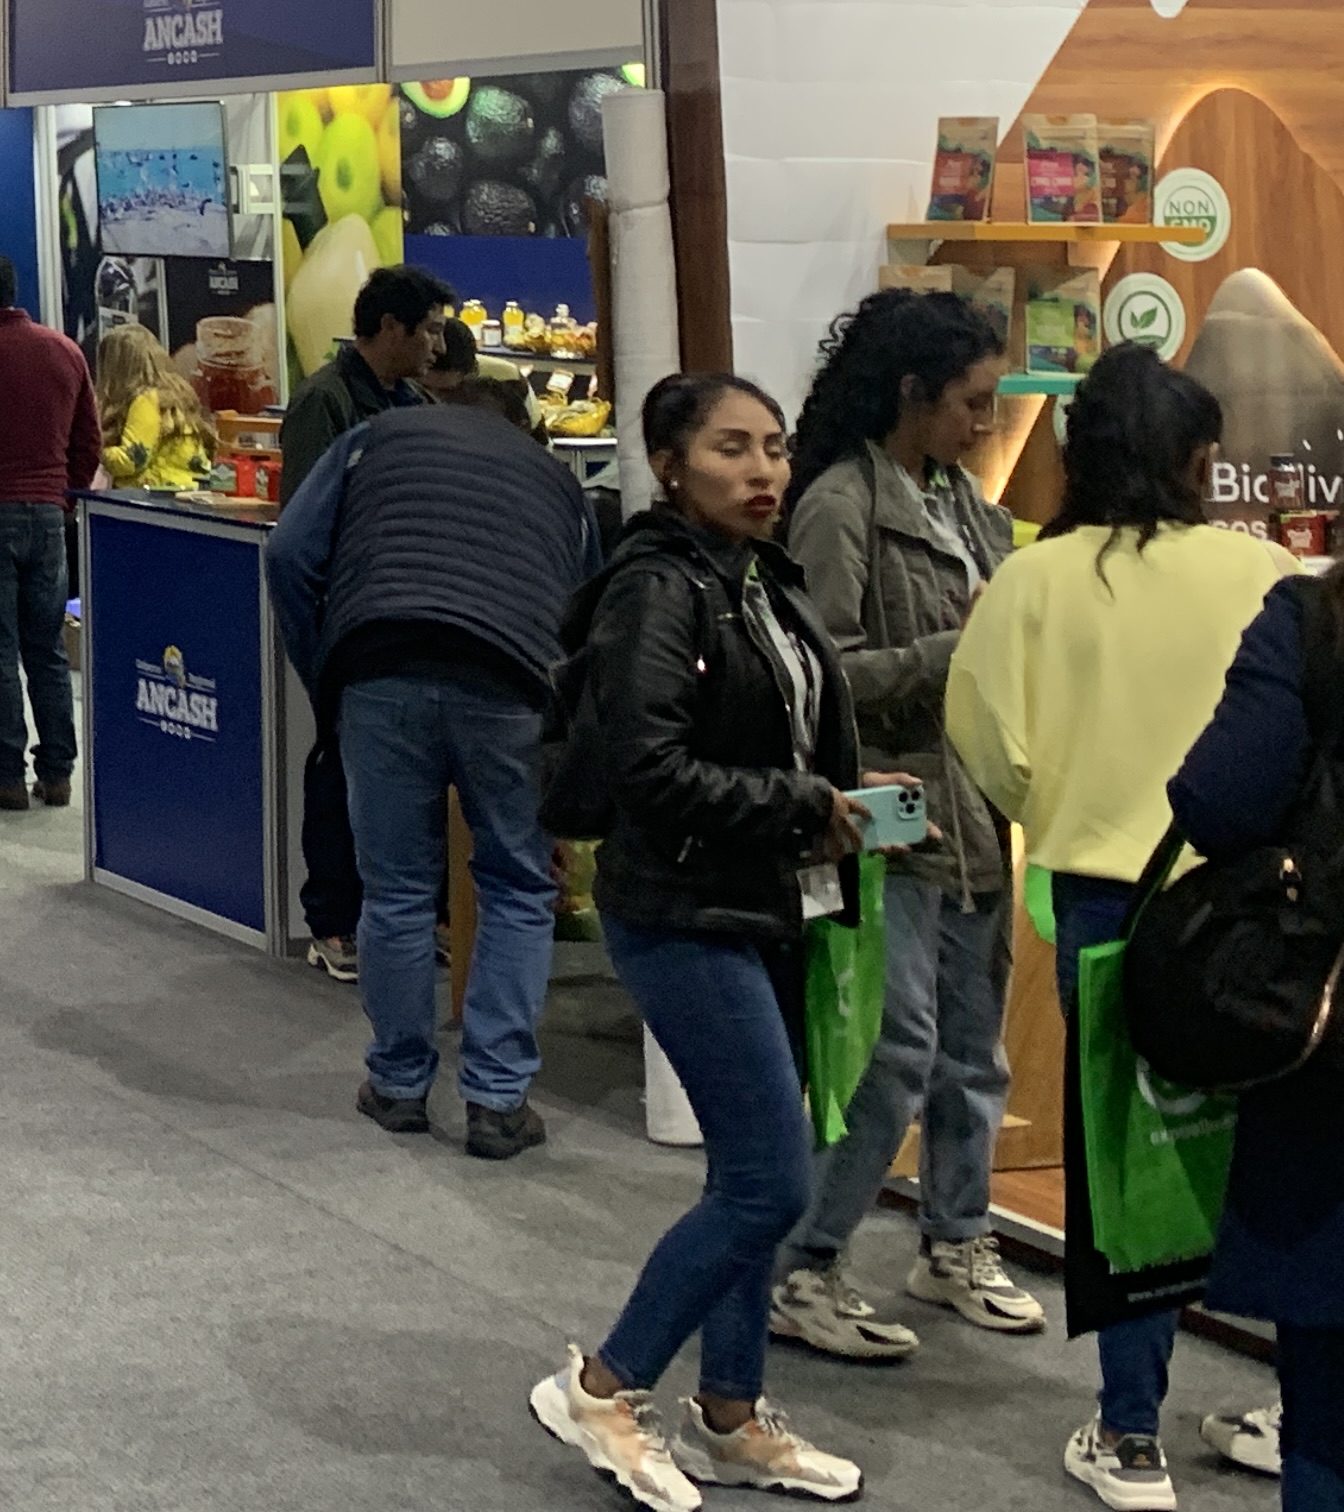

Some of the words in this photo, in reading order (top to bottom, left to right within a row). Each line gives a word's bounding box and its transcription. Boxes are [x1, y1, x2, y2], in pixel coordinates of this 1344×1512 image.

[143, 9, 224, 52] ANCASH
[1169, 200, 1211, 215] NON
[136, 679, 218, 732] ANCASH
